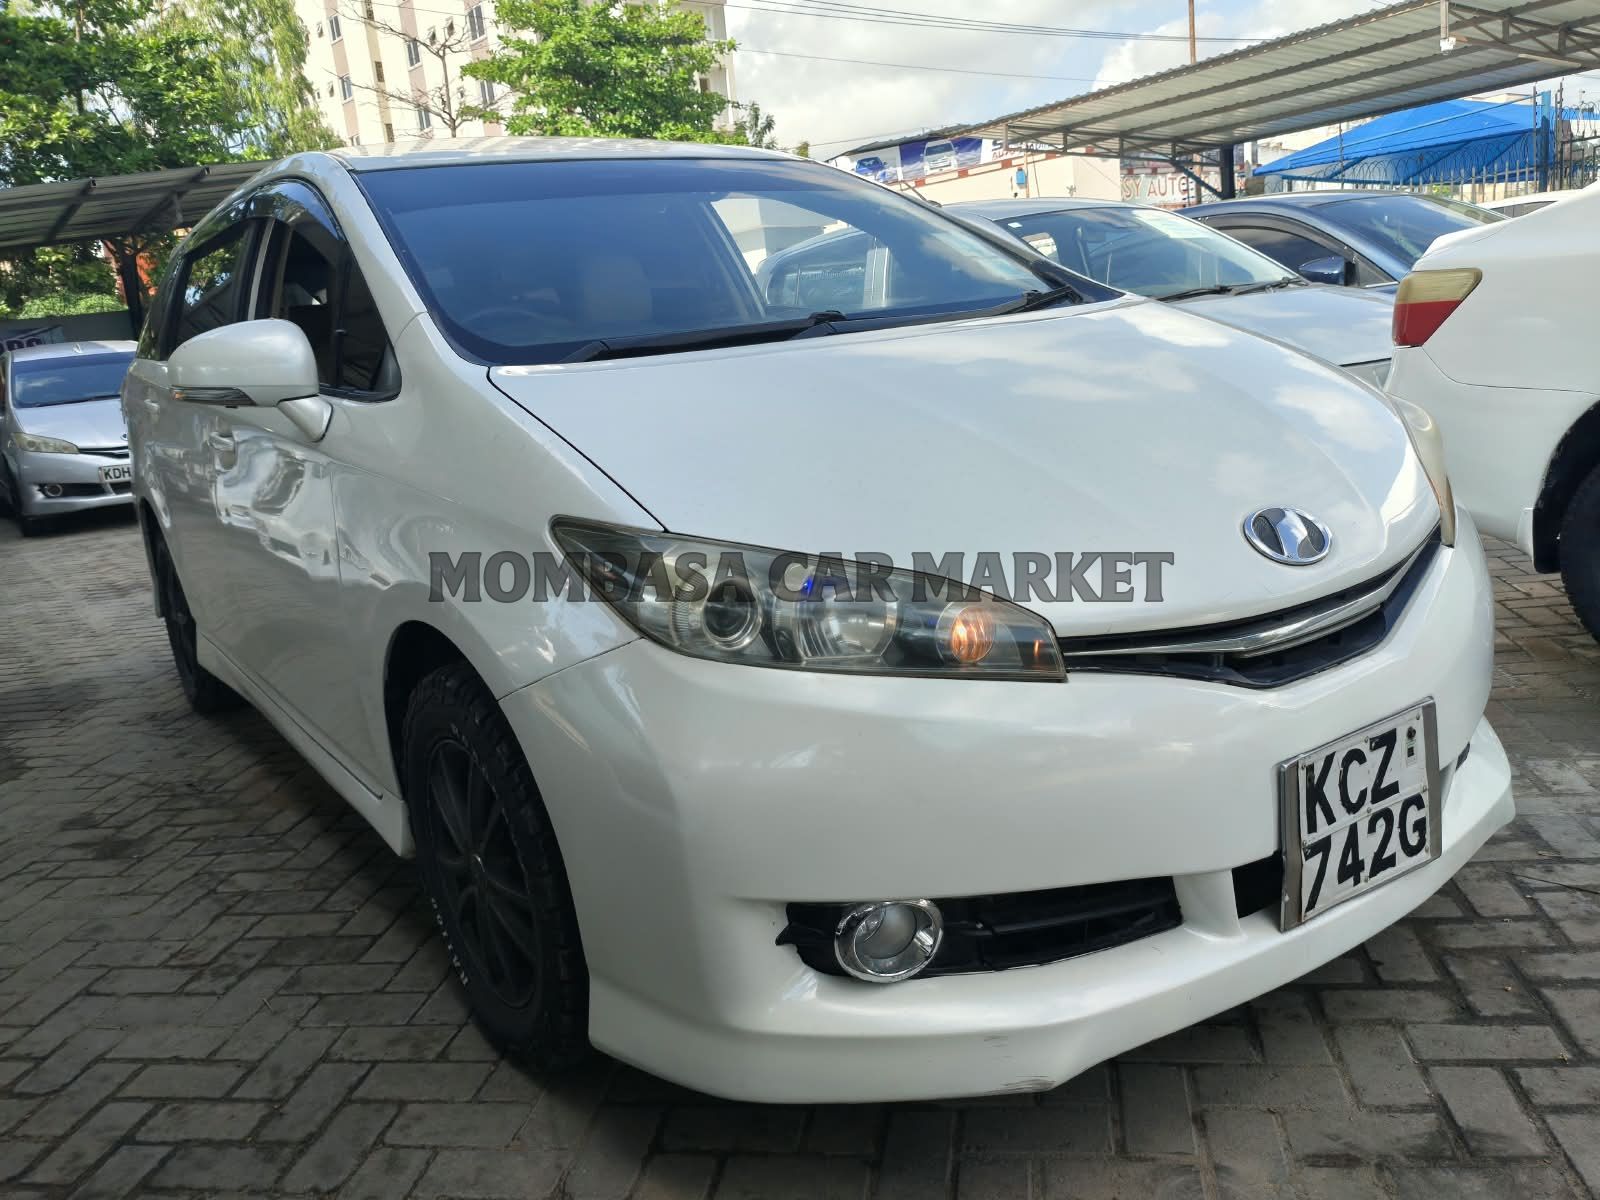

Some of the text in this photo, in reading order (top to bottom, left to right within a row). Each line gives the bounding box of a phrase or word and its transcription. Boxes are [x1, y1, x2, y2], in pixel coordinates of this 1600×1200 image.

[103, 466, 131, 480] KDH
[1306, 728, 1400, 835] KCZ
[1305, 793, 1427, 913] 742G
